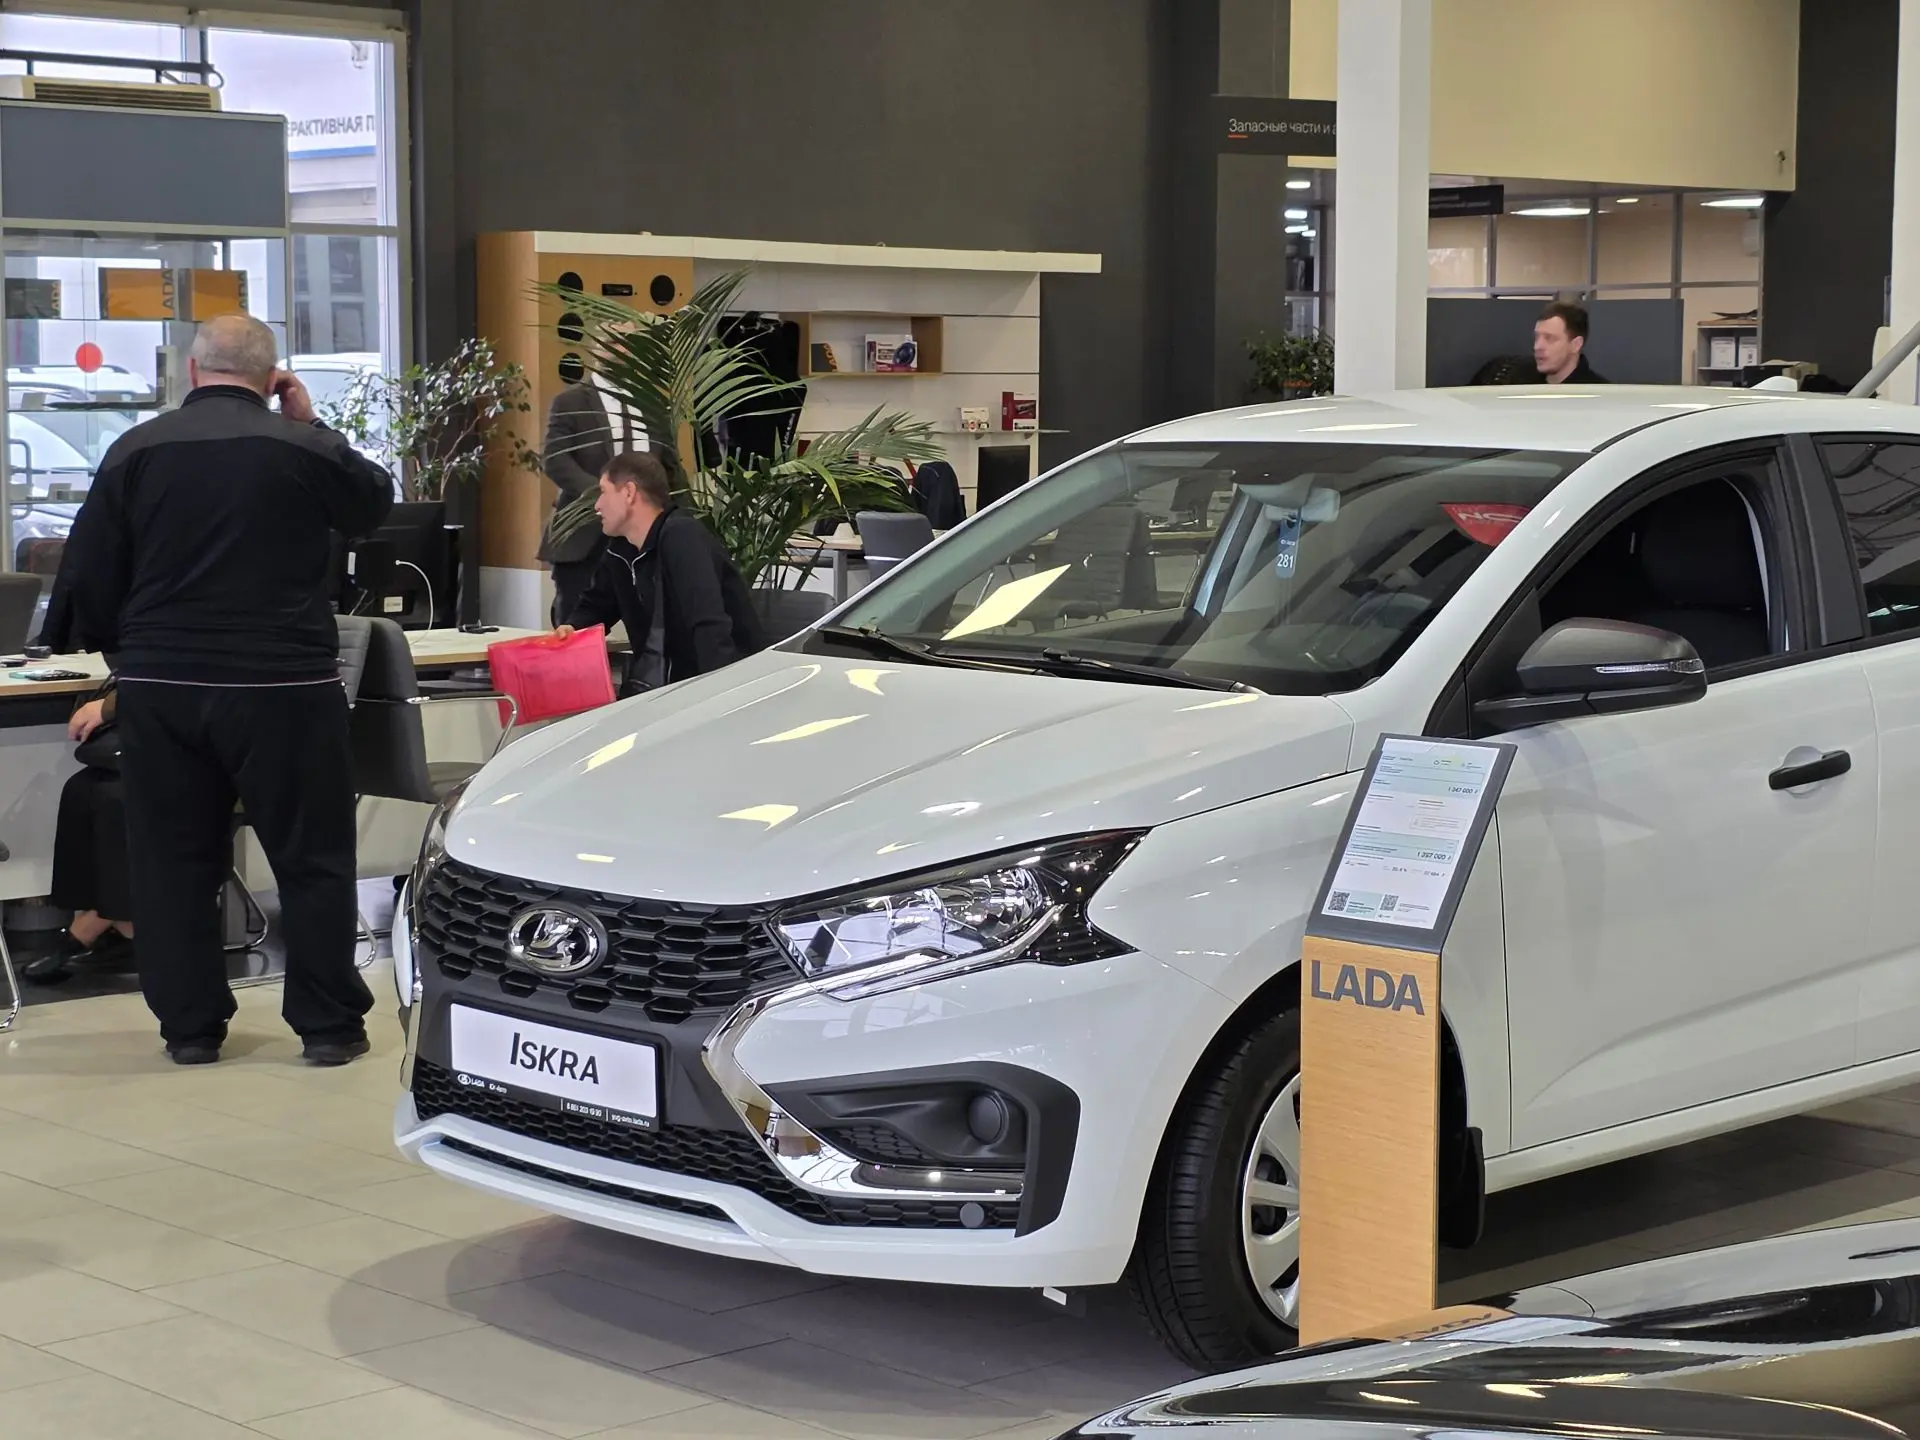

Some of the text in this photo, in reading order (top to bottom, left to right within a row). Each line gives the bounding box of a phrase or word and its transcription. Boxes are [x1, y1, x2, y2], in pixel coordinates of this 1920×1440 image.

[1228, 118, 1287, 133] Запасные
[1289, 121, 1321, 134] части
[1322, 123, 1331, 134] и
[1277, 553, 1295, 569] 281
[1311, 960, 1425, 1016] LADA
